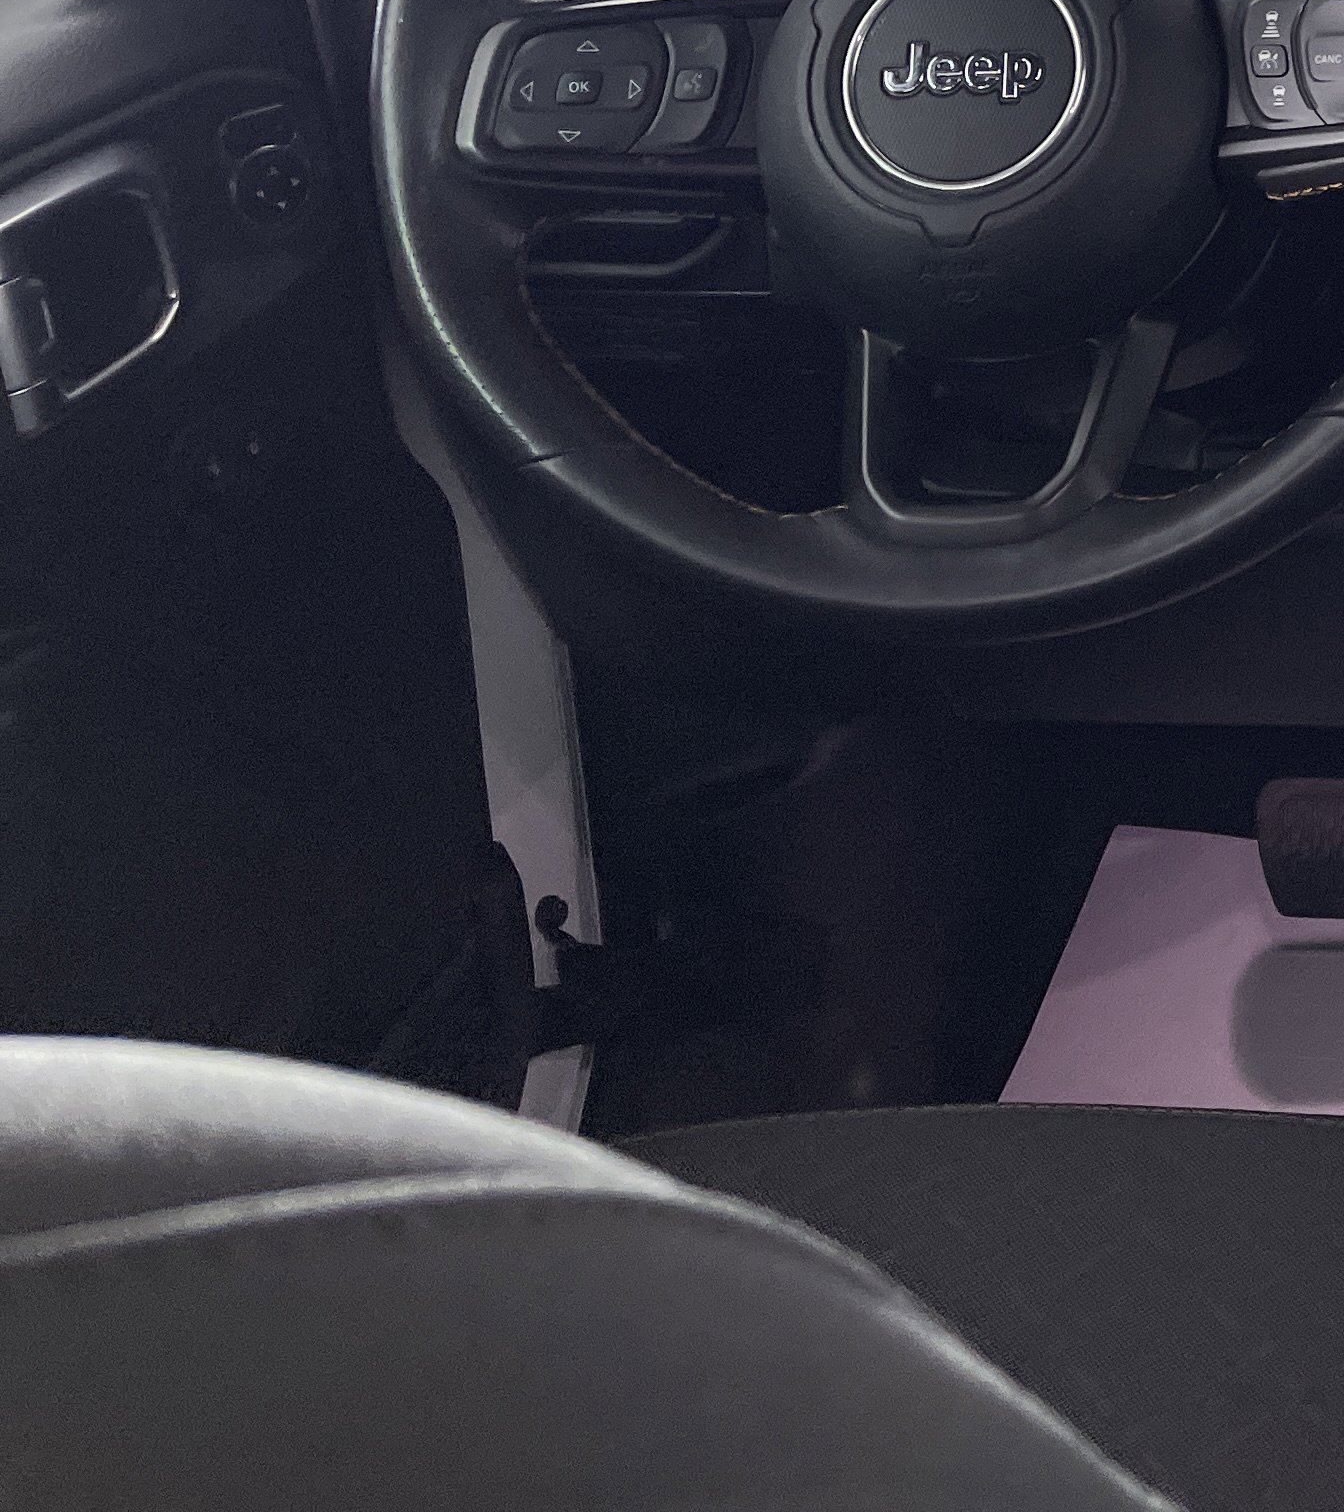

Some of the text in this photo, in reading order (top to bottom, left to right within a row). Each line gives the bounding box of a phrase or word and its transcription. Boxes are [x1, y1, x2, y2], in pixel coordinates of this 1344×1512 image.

[1314, 53, 1342, 65] CANC
[882, 41, 1043, 99] Jeep
[568, 80, 589, 93] OK
